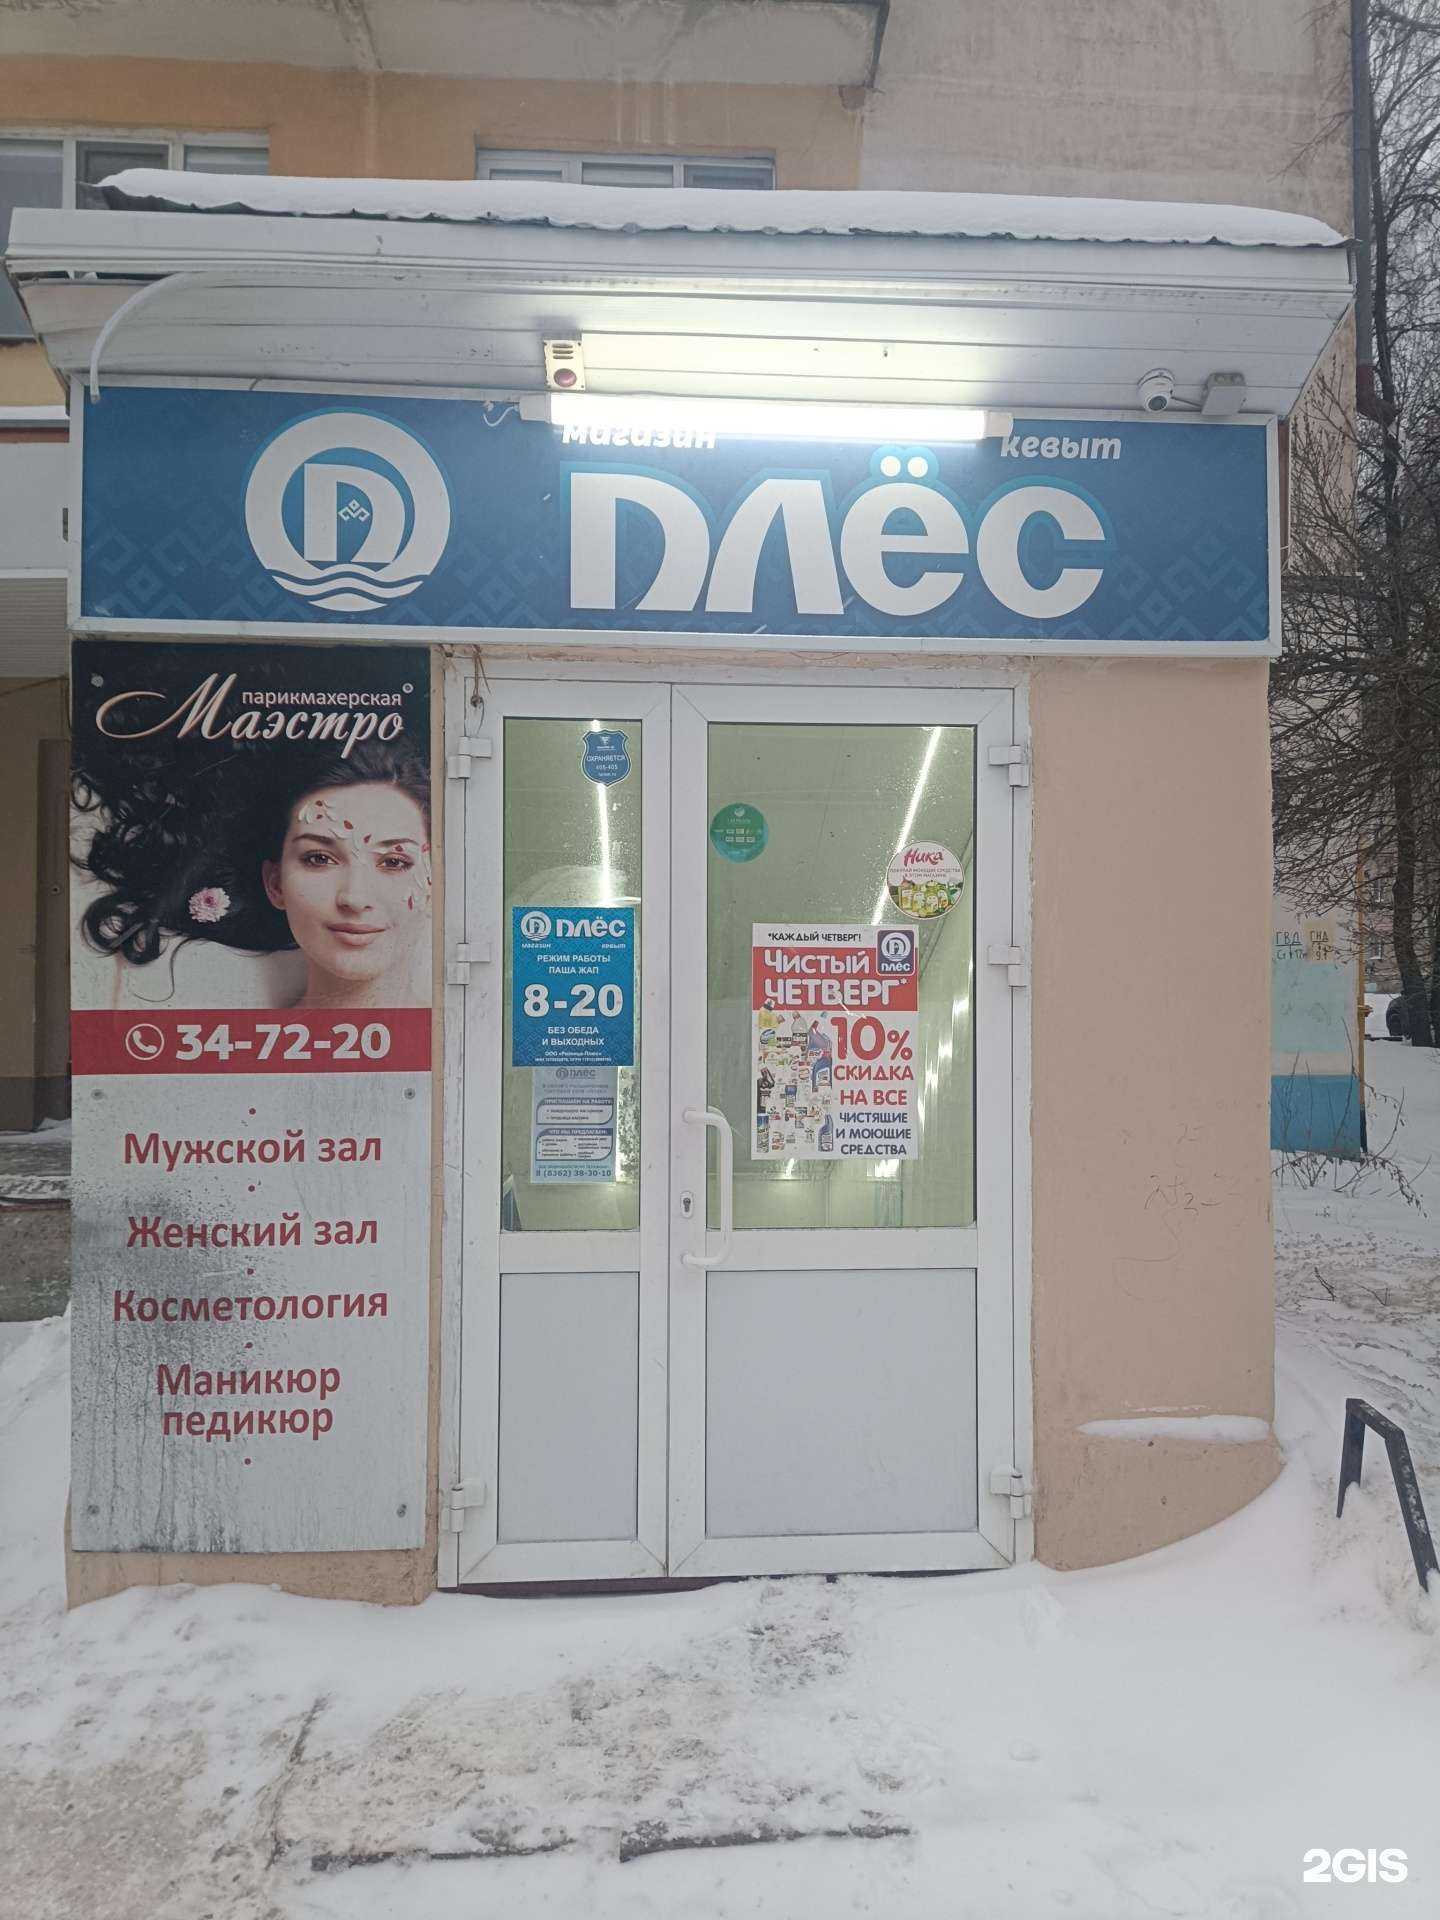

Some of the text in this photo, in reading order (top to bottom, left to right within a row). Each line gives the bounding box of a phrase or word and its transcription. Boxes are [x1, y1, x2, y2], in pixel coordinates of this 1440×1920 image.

[1000, 435, 1121, 459] кевыт
[242, 691, 401, 709] парикмахерская
[96, 673, 404, 759] Маэстро
[904, 849, 943, 867] Ника
[822, 933, 862, 942] ЧЕТВЕРГ!
[549, 966, 599, 974] ПАША ЖАП
[523, 984, 623, 1017] 8-20
[548, 1026, 599, 1035] БЕЗ ОБЕДА
[831, 1016, 913, 1061] 10%
[176, 1024, 391, 1060] 34-72-20
[551, 1039, 604, 1047] ВЫХОДНЫХ
[834, 1065, 914, 1081] СКИДКА
[840, 1089, 907, 1106] НА ВСЕ
[839, 1112, 908, 1124] ЧИСТЯЩИЕ
[836, 1128, 911, 1140] И МОЮЩИЕ
[124, 1129, 381, 1172] Мужской зал
[841, 1144, 907, 1155] СРЕДСТВА
[127, 1212, 377, 1248] Женский зал
[113, 1290, 388, 1321] Косметология
[157, 1363, 340, 1400] Маникюр
[163, 1408, 333, 1442] педикюр
